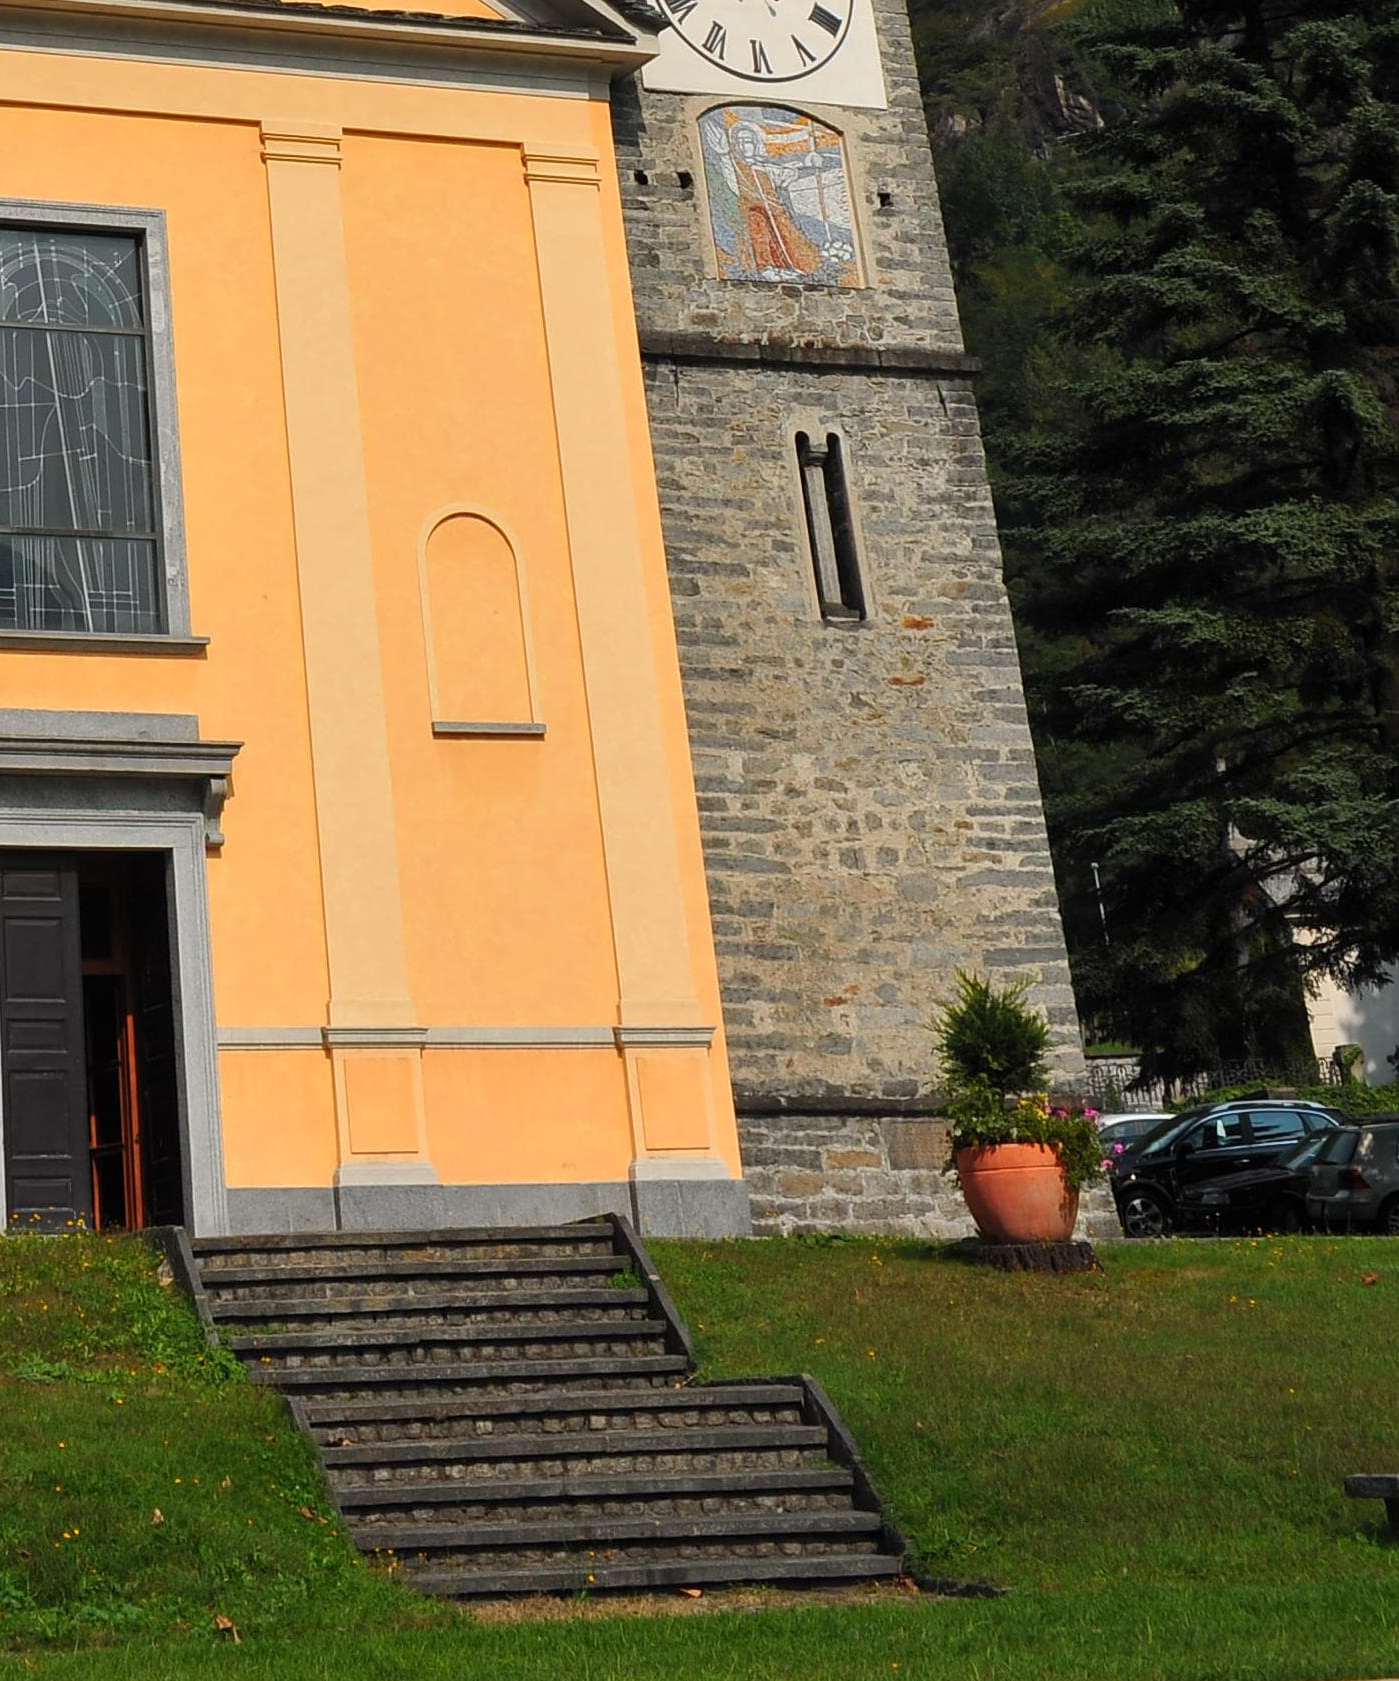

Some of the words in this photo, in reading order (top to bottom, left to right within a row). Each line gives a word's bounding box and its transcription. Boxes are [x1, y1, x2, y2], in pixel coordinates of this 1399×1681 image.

[808, 1, 843, 38] IIII
[701, 20, 727, 61] VII
[749, 39, 773, 74] VI
[790, 34, 817, 67] V
